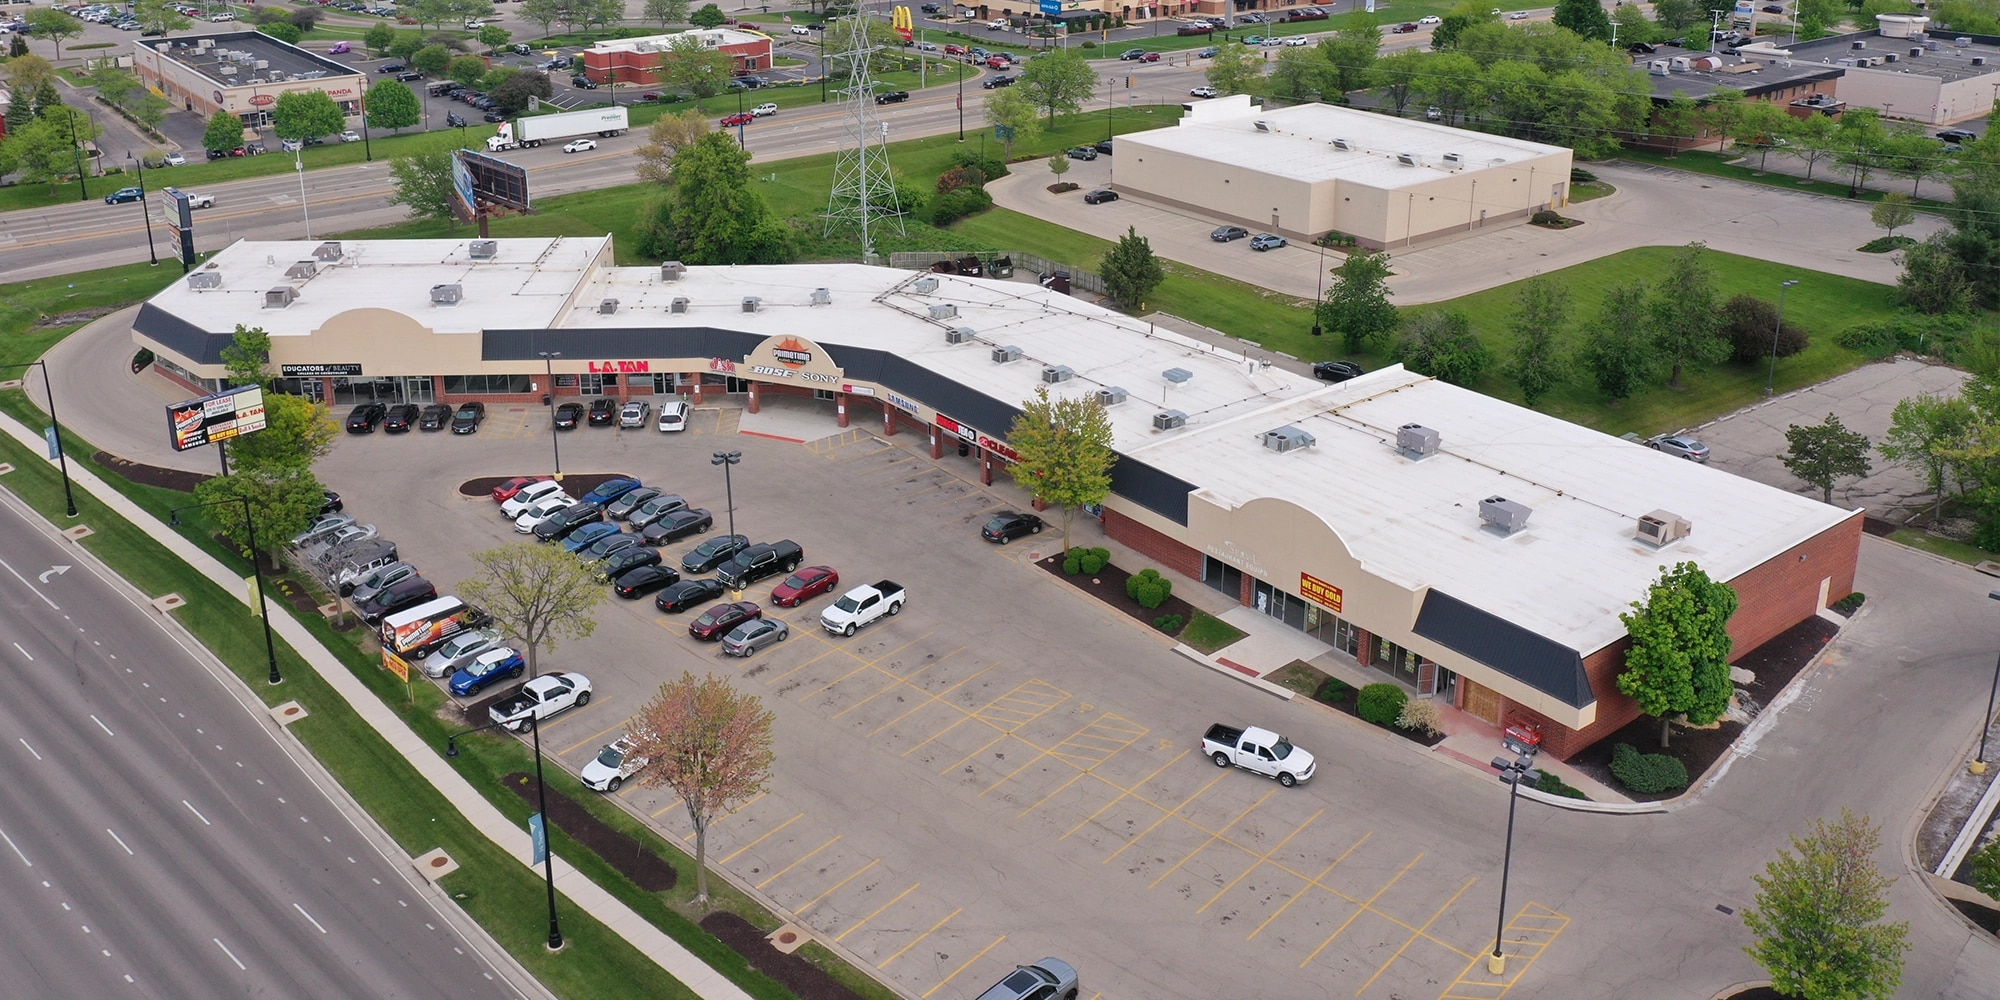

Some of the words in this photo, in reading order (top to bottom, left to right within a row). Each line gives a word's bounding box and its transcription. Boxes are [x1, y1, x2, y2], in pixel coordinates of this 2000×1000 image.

[589, 361, 617, 372] L.A.
[618, 361, 648, 372] TAN
[752, 365, 798, 378] BOSE
[801, 372, 839, 385] SONY
[887, 393, 919, 414] SAMSUNG
[249, 408, 264, 416] TAN
[183, 435, 202, 443] SONY
[1302, 578, 1312, 590] WE
[1312, 583, 1324, 596] BUY
[1325, 589, 1341, 603] GOLD
